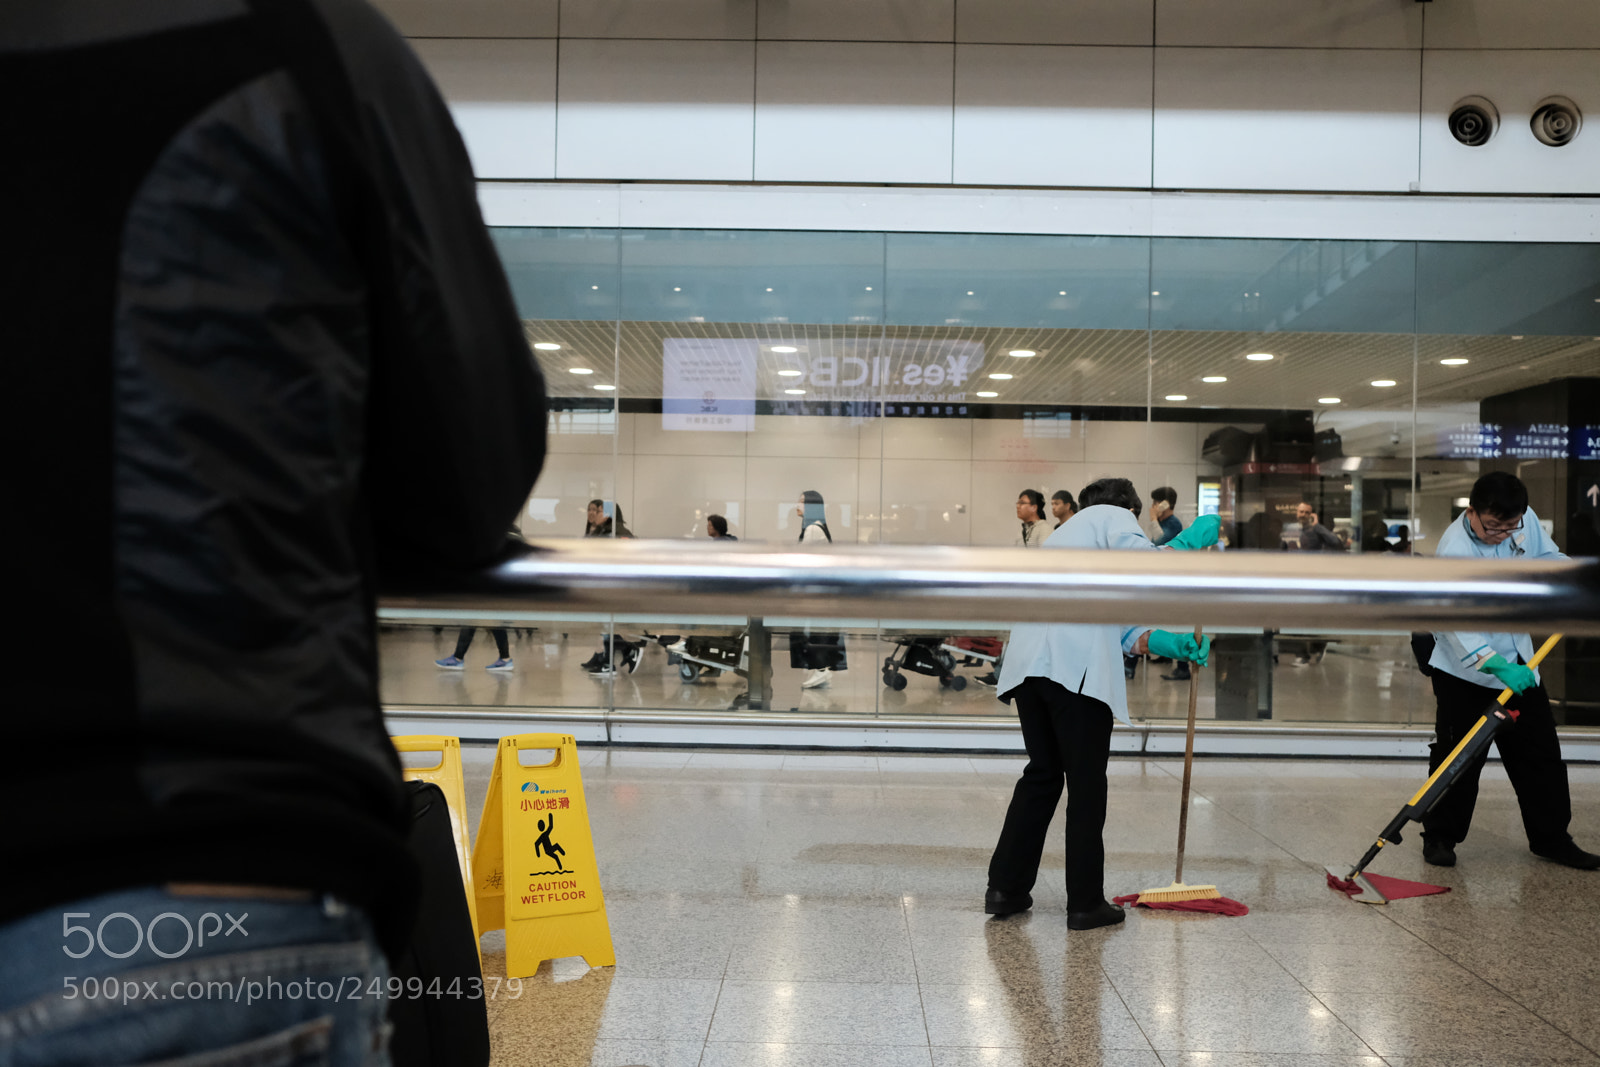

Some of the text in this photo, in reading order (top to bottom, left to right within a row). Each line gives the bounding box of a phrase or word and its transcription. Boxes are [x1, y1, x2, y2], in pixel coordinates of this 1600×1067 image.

[520, 797, 570, 811] 小心地滑
[528, 880, 577, 892] CAUTION
[521, 890, 586, 904] WET FLOOR
